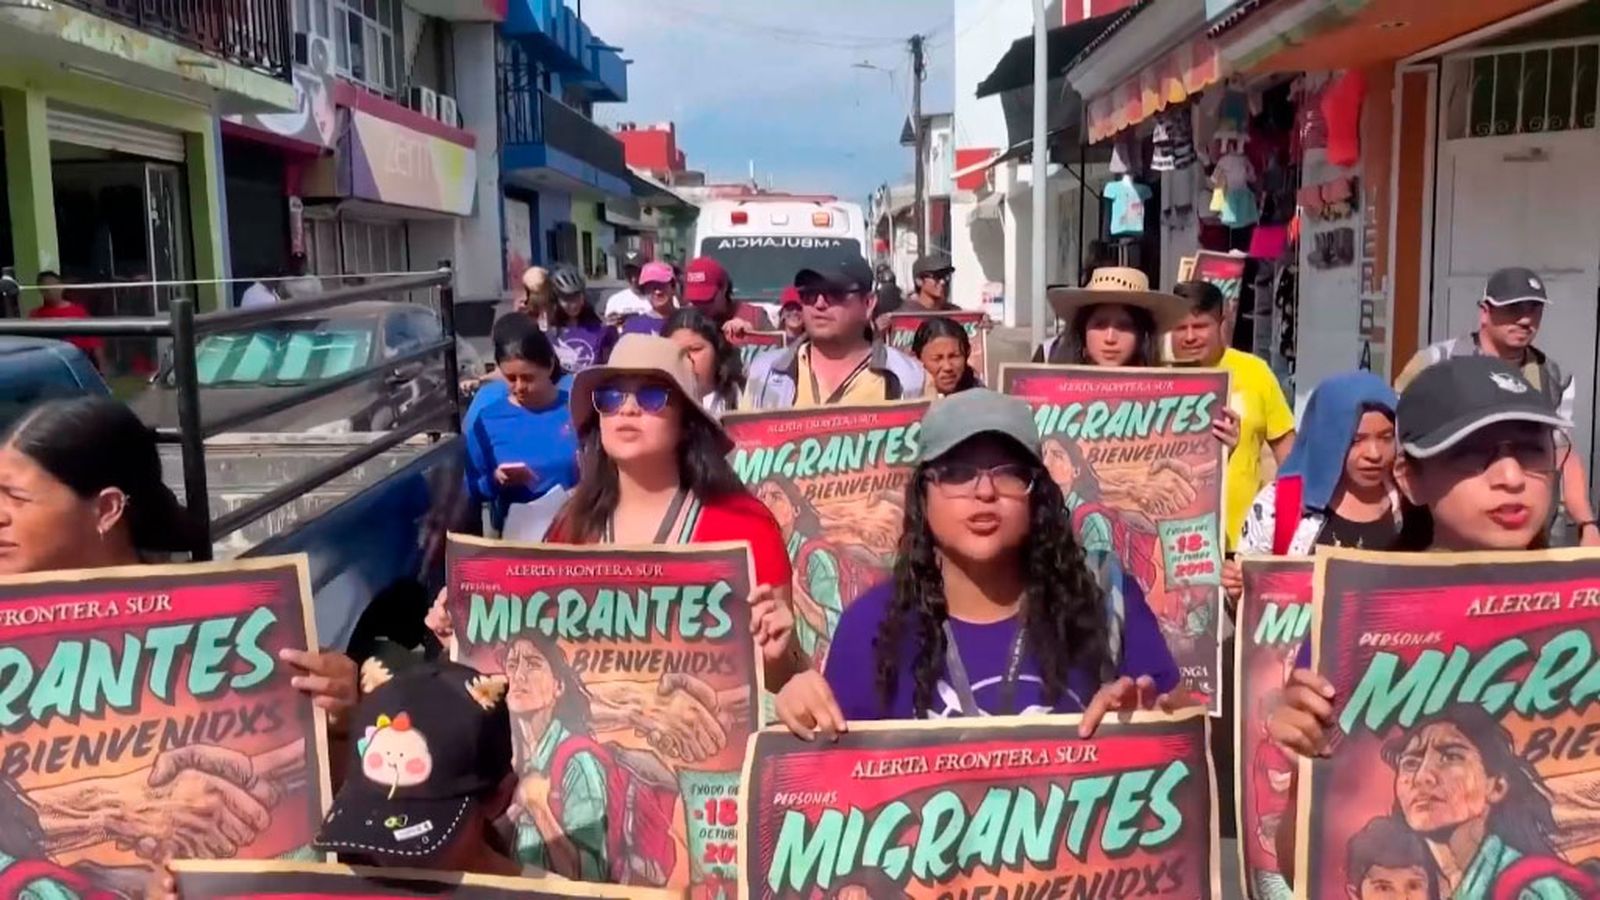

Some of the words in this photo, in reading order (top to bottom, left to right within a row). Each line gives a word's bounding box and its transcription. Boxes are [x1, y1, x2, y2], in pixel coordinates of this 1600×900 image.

[733, 422, 921, 484] MIGRANTES
[804, 472, 906, 499] BIENVENID
[505, 564, 555, 577] ALERTA
[557, 565, 633, 577] FRONTERA
[635, 563, 664, 577] SUR
[125, 593, 172, 614] SUR
[467, 581, 733, 644] MIGRANTES
[1466, 591, 1561, 616] ALERTA
[1568, 586, 1600, 609] FR
[1358, 631, 1444, 647] PERSONAS
[571, 648, 737, 675] BIENVENIDXS
[1179, 665, 1208, 677] NGA
[1, 703, 284, 778] BIENVENIDXS
[850, 757, 930, 778] ALERTA
[935, 749, 1051, 770] FRONTERA
[1055, 743, 1099, 764] SUR
[772, 791, 839, 805] PERSONAS
[699, 827, 738, 841] OCTUB
[768, 759, 1191, 895] MIGRANTES
[703, 842, 738, 865] 20
[936, 857, 1186, 900] IENVENIDXS
